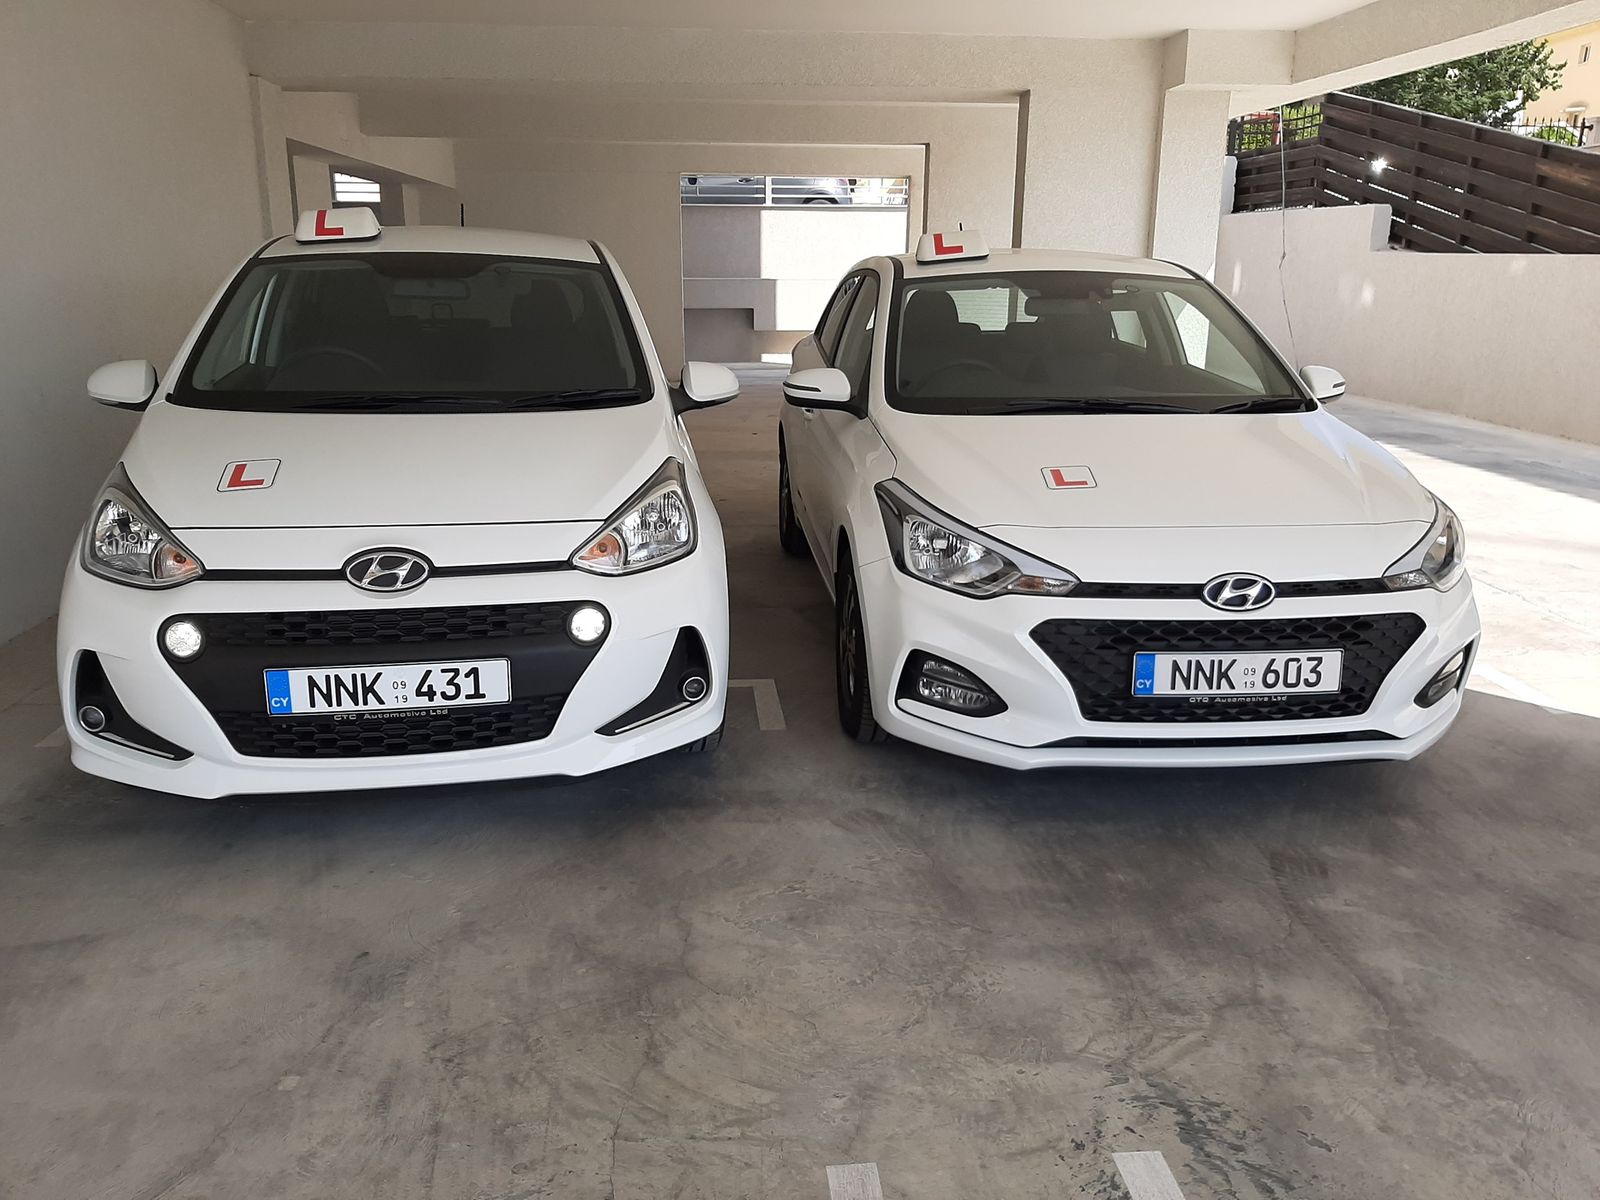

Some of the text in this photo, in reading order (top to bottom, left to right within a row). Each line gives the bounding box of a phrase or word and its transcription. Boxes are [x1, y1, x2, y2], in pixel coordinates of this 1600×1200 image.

[314, 209, 345, 237] L
[932, 233, 964, 256] L
[228, 463, 264, 488] L
[1049, 468, 1088, 487] L
[1170, 656, 1324, 691] NNK 603
[1243, 667, 1257, 676] 09
[306, 665, 487, 709] NNK 431
[392, 680, 407, 690] 09
[1136, 679, 1152, 689] CY
[1243, 680, 1256, 689] 19
[271, 696, 290, 708] CY
[394, 694, 408, 704] 19
[333, 708, 449, 721] CTC Automotive Ltd
